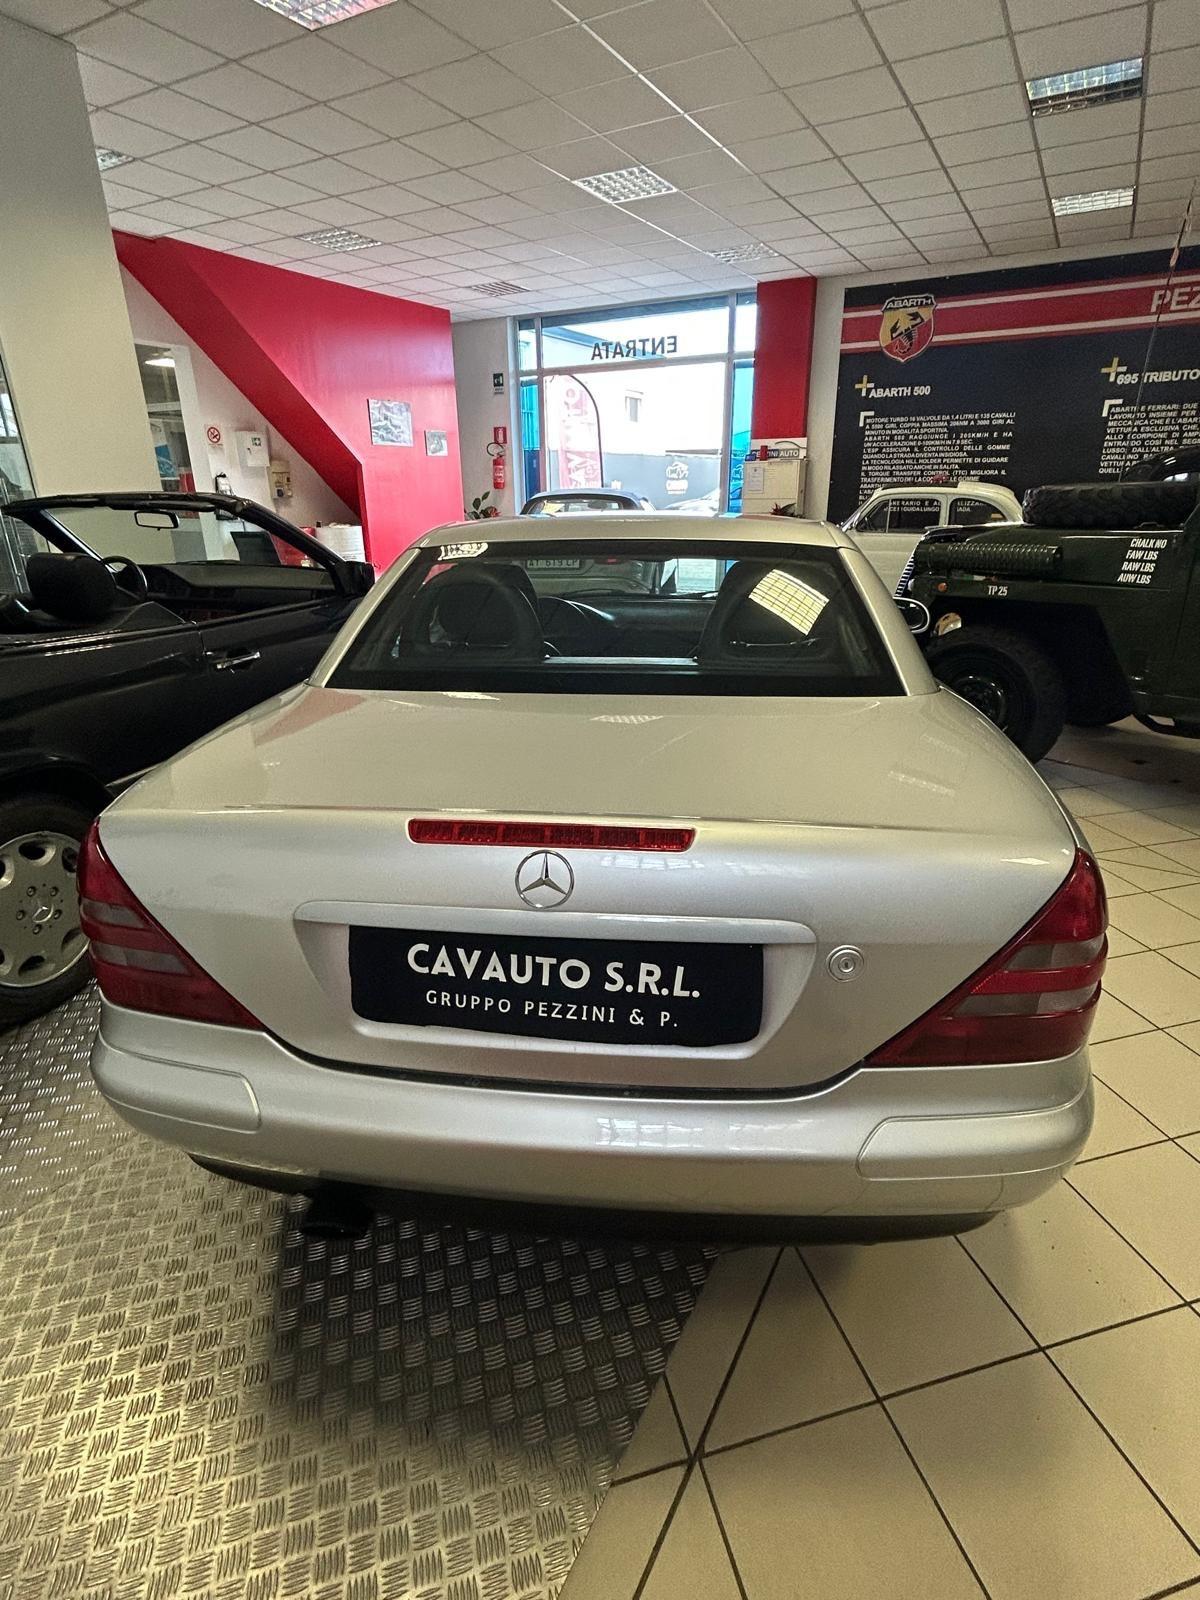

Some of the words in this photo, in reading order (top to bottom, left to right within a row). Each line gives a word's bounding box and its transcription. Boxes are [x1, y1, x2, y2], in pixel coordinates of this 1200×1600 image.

[886, 298, 931, 309] ABARTH
[1116, 373, 1140, 384] 695
[1142, 369, 1200, 383] TRIBUTO
[868, 386, 911, 398] ABARTH
[913, 386, 931, 396] 500
[1130, 538, 1155, 548] CHALK
[1154, 539, 1168, 548] NO
[1126, 550, 1144, 560] FAW
[1143, 550, 1158, 560] LBS
[1122, 562, 1142, 571] RAW
[1140, 562, 1156, 572] LBS
[1136, 574, 1152, 584] LBS
[988, 585, 998, 595] TP
[998, 586, 1008, 596] 25
[407, 943, 591, 990] CAVAUTO
[604, 962, 700, 998] S.R.L.
[426, 990, 510, 1014] GRUPPO
[525, 1000, 616, 1024] PEZZINI
[629, 1008, 644, 1026] &
[660, 1012, 679, 1028] P.
